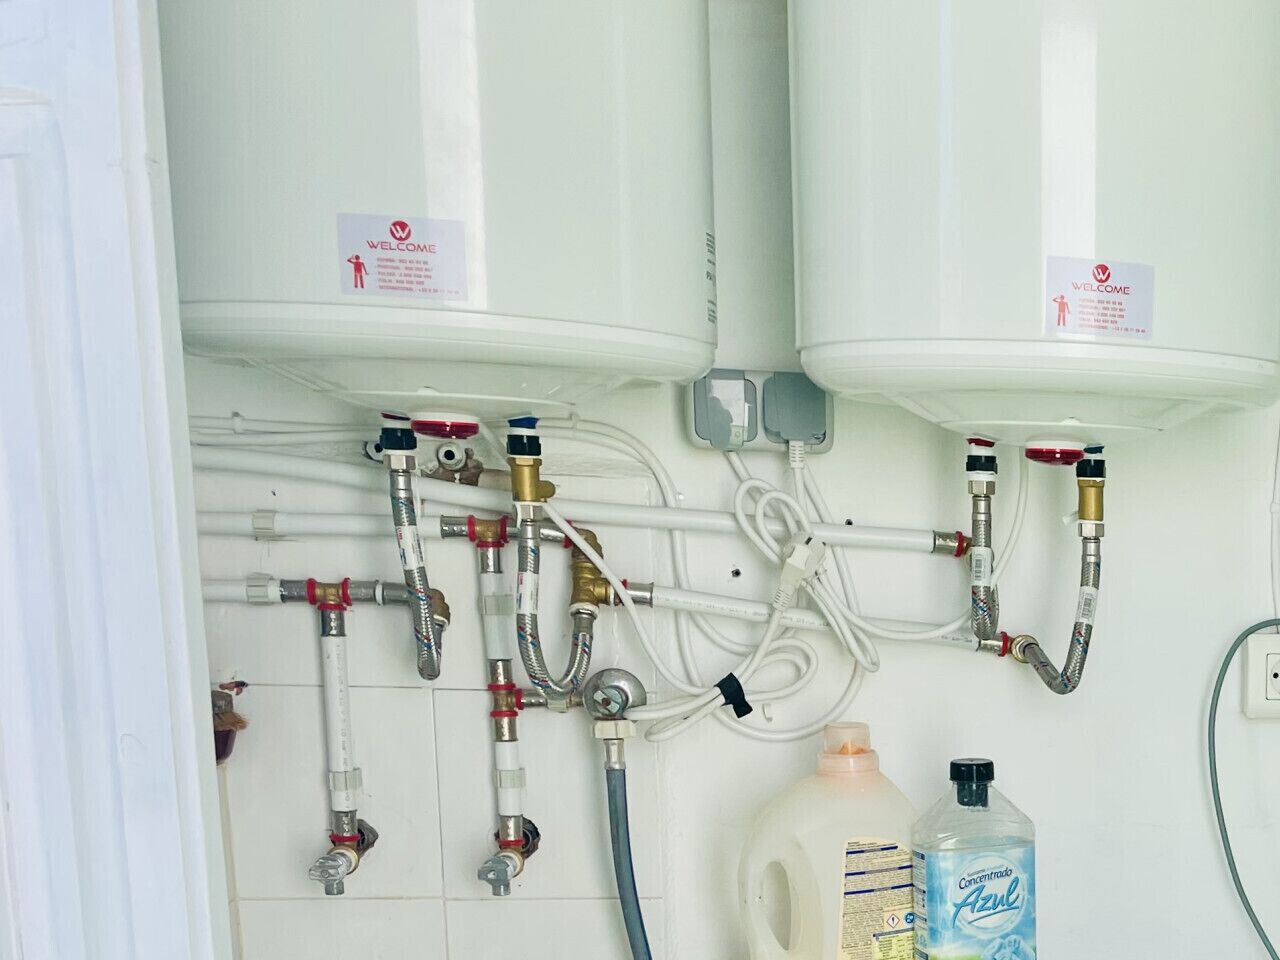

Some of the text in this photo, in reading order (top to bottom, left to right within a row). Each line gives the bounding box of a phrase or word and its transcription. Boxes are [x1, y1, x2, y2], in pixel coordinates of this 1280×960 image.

[367, 240, 437, 254] WELCOME
[1072, 281, 1130, 295] WELCOME
[959, 867, 1013, 889] Concentrado
[952, 876, 1020, 928] Azul
